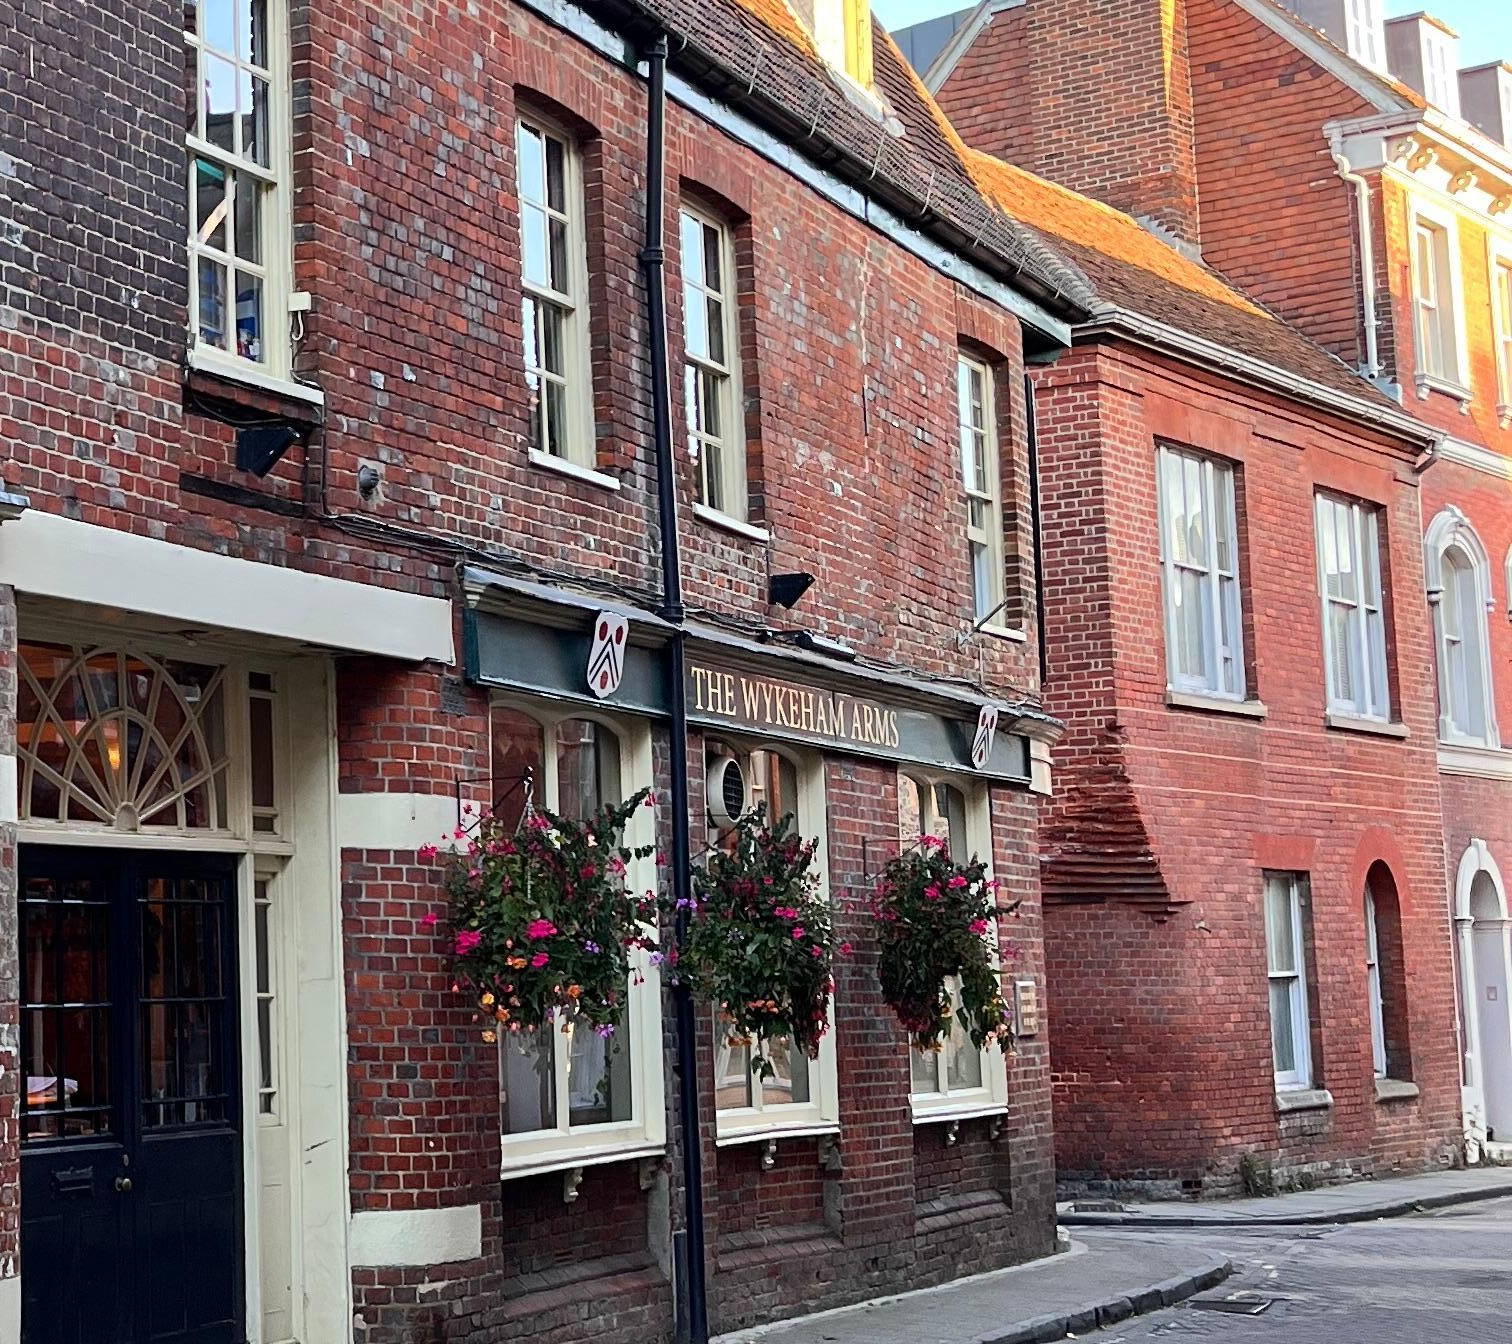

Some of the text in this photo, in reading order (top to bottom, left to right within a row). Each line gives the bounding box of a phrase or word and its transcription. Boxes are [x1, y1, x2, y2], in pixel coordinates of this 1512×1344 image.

[691, 666, 900, 749] THE WYKEHAM ARMS
